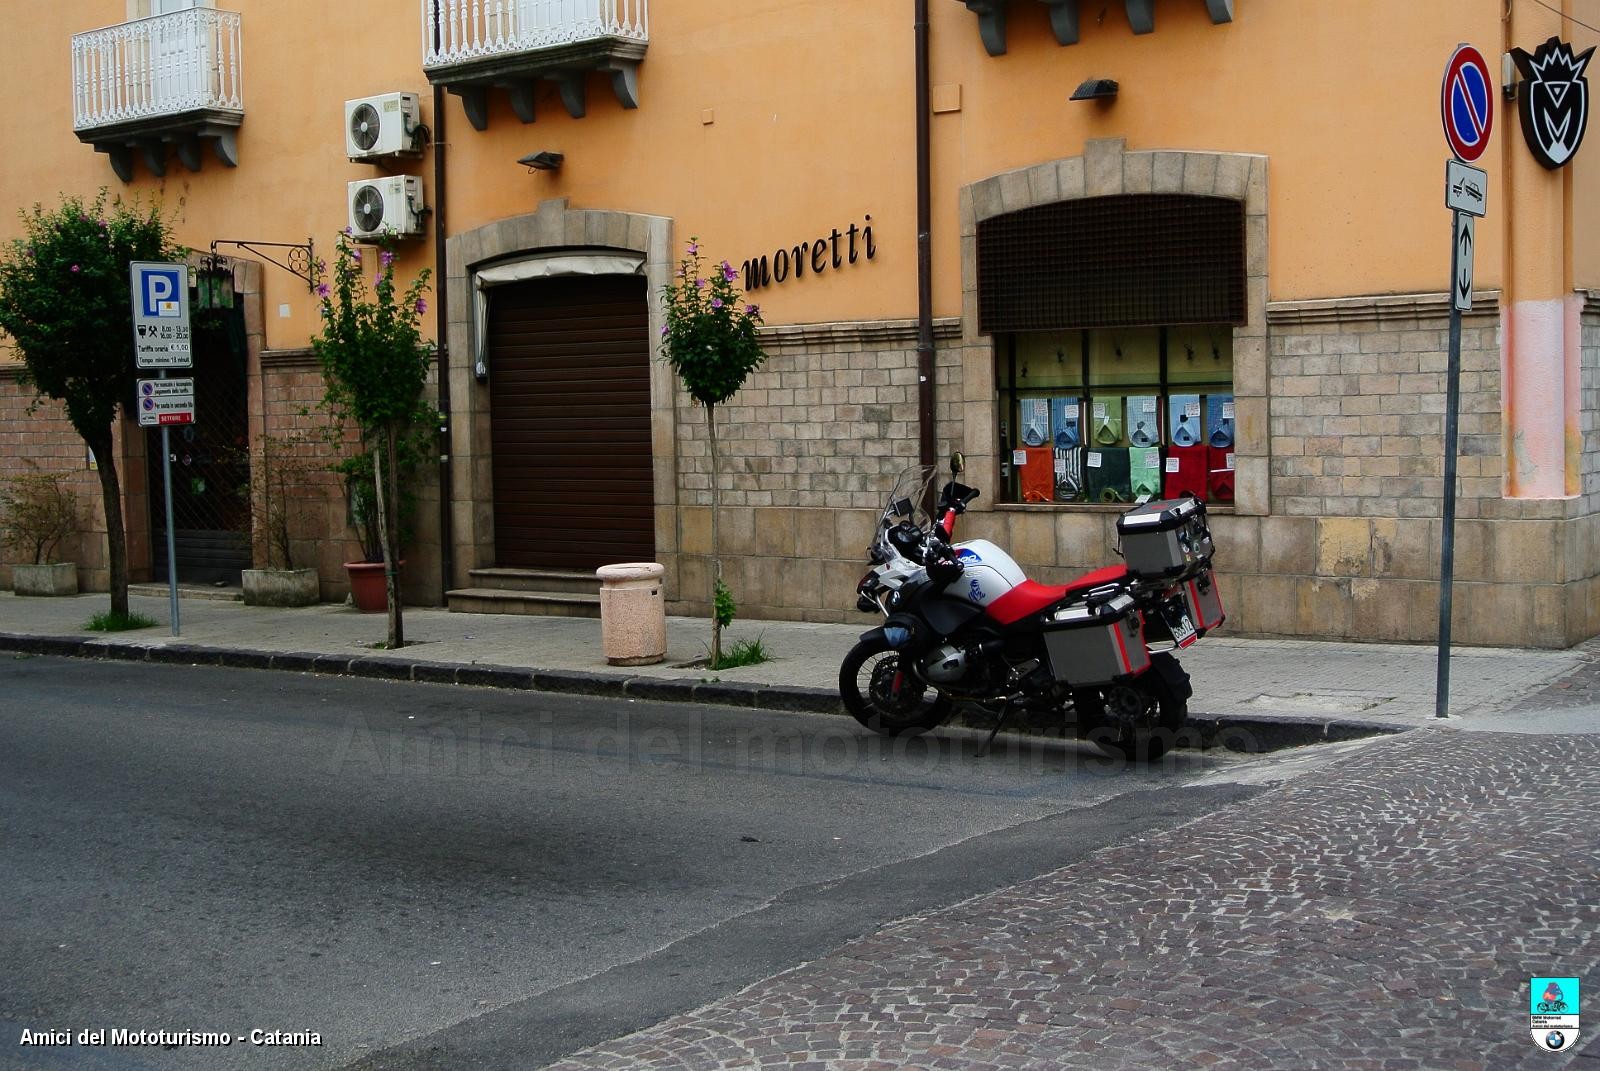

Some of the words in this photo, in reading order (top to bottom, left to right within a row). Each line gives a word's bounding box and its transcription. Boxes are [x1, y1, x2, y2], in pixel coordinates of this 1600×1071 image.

[740, 214, 876, 292] moretti
[148, 274, 173, 313] P
[138, 345, 153, 353] Tariffa
